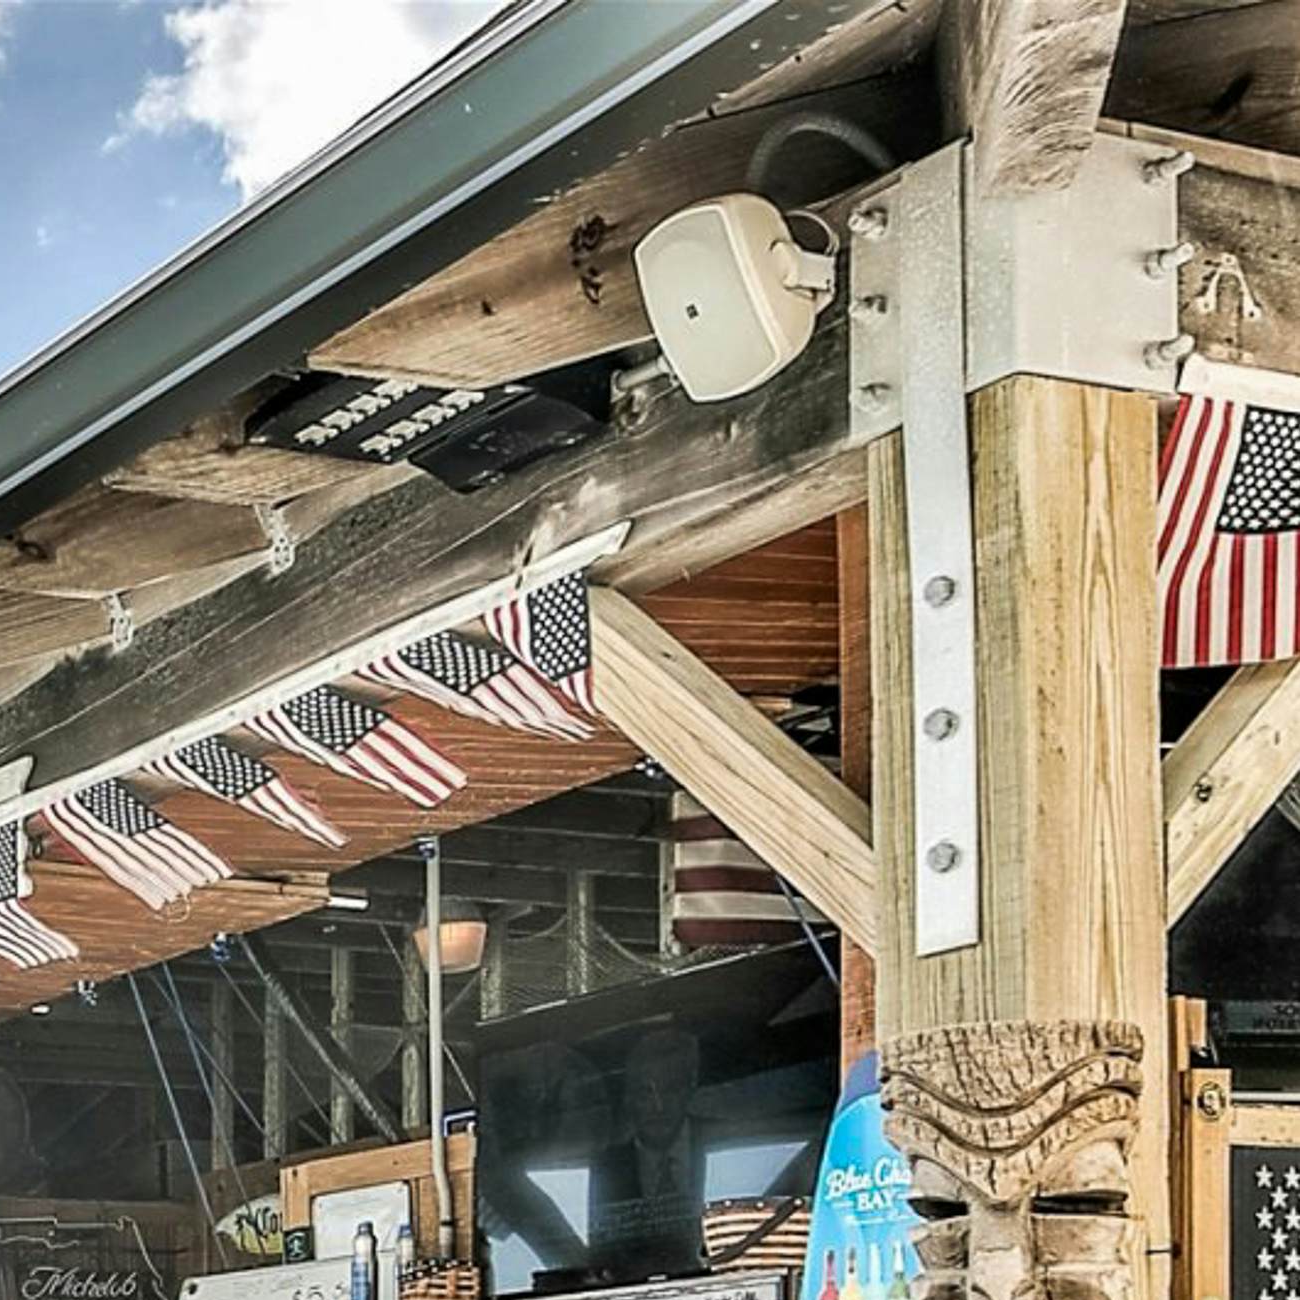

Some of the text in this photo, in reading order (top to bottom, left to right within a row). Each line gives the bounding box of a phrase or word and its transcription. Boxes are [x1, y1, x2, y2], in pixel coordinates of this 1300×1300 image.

[826, 1156, 913, 1200] Blue Cha
[856, 1190, 893, 1212] BAY
